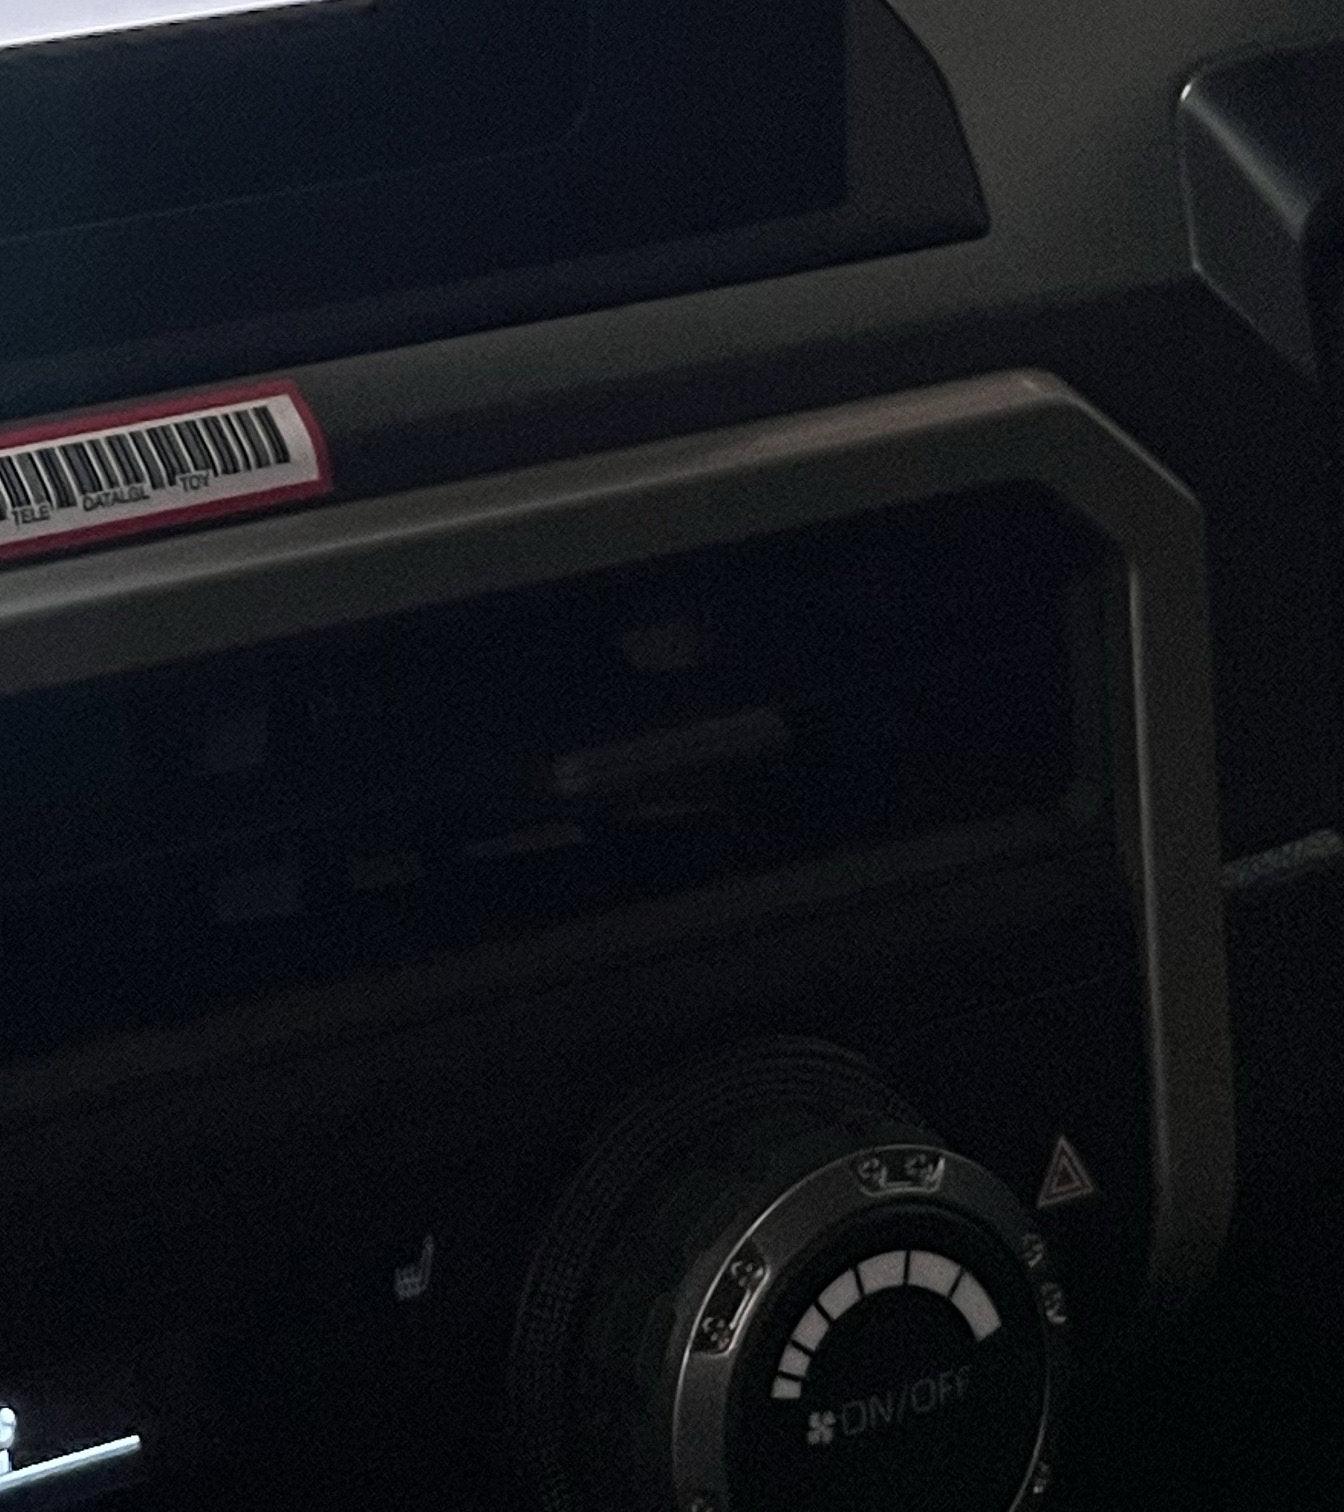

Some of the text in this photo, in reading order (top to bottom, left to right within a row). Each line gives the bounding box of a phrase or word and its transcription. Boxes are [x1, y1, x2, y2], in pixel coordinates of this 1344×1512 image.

[10, 504, 51, 528] TELE
[178, 470, 211, 493] TOY
[841, 1365, 971, 1436] ON/OFF
